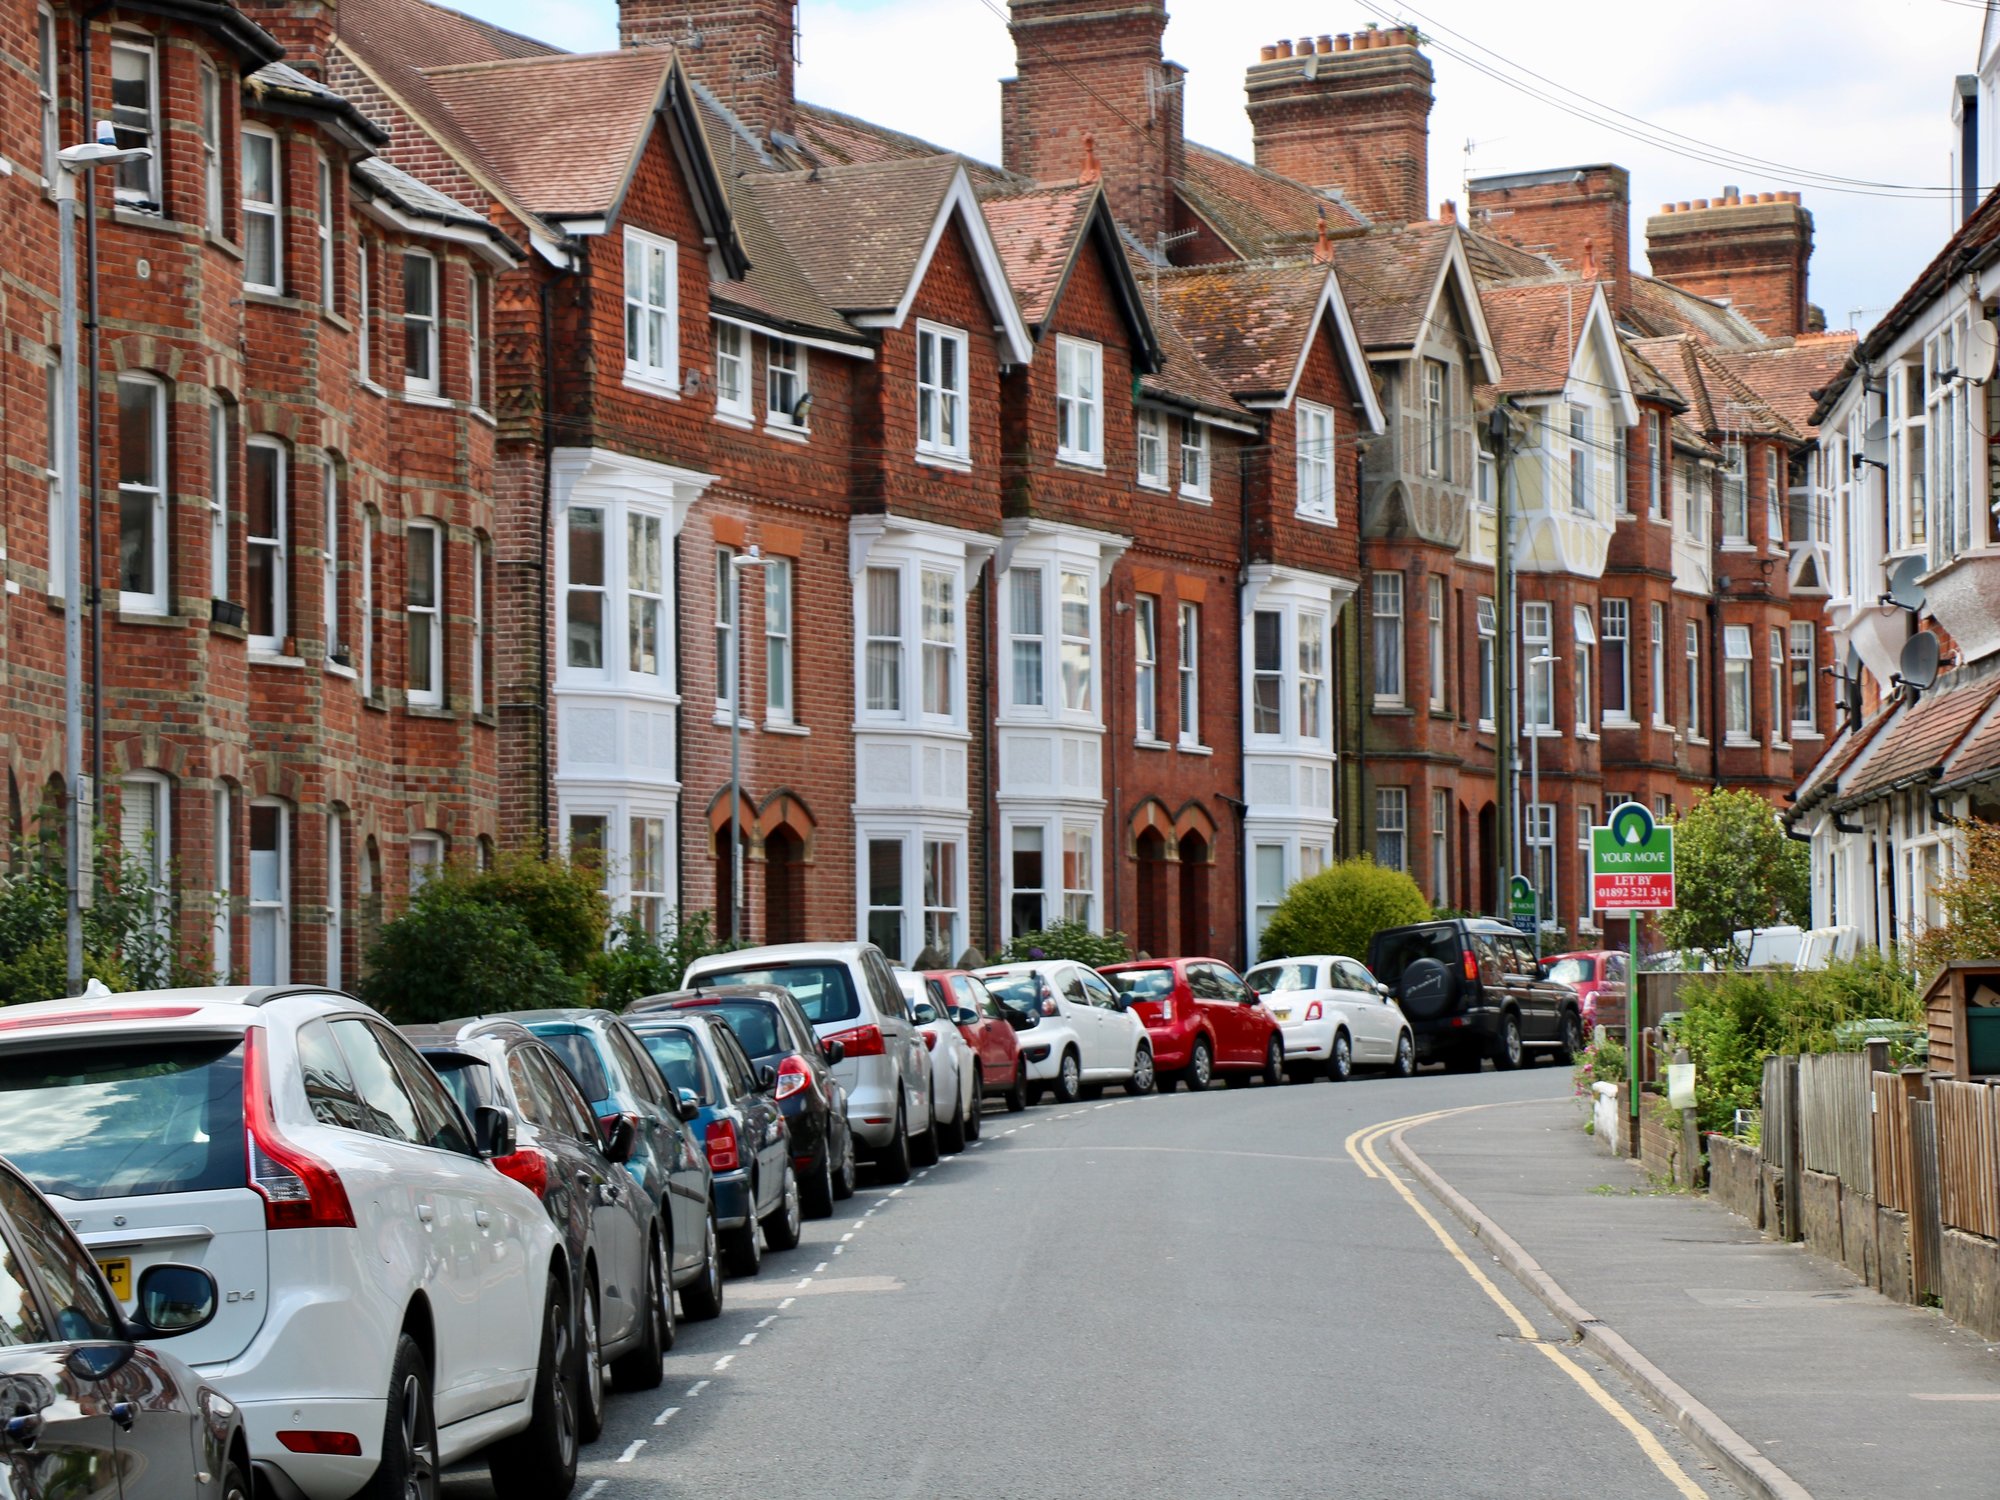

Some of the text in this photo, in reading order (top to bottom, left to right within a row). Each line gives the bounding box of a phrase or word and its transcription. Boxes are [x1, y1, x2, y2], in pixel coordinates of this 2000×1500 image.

[1601, 852, 1665, 863] YOUR MOVE
[1615, 876, 1652, 886] LET BY
[1598, 887, 1629, 897] 01892
[1630, 887, 1647, 897] 521
[226, 1288, 256, 1303] D4
